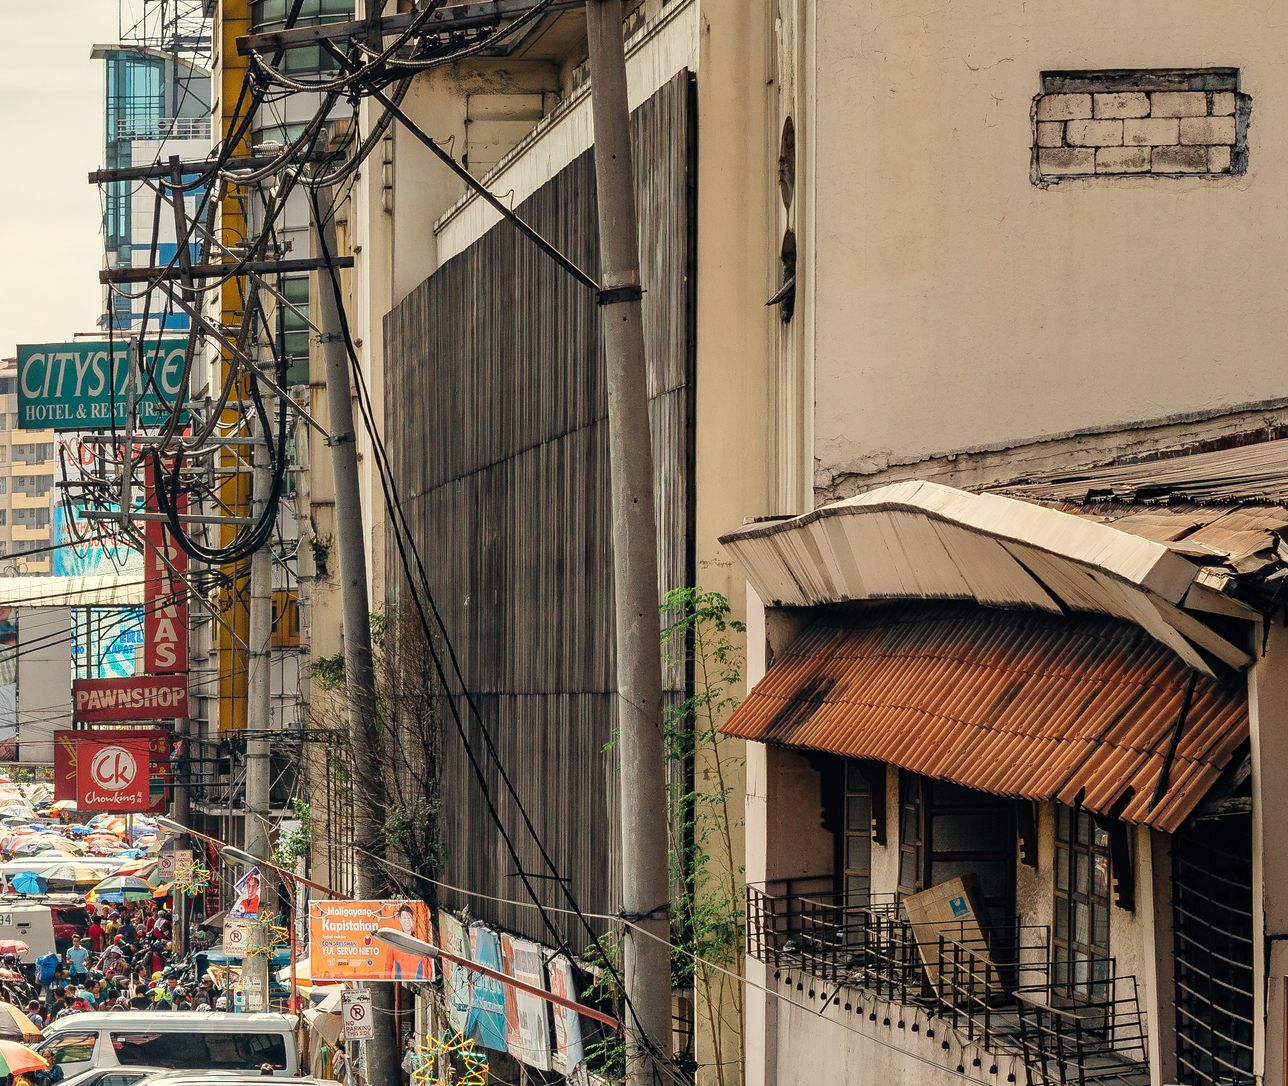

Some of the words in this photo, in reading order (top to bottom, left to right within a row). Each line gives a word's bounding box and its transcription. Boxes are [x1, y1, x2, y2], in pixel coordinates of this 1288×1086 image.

[24, 403, 74, 421] HOTEL
[76, 403, 87, 419] &
[76, 686, 185, 711] PAWNSHOP
[85, 791, 136, 805] Chowking
[327, 906, 372, 918] Maligayang
[322, 919, 379, 932] Kapistahan
[322, 947, 336, 955] YUL
[336, 947, 358, 955] SERVO
[359, 947, 380, 955] NIETO
